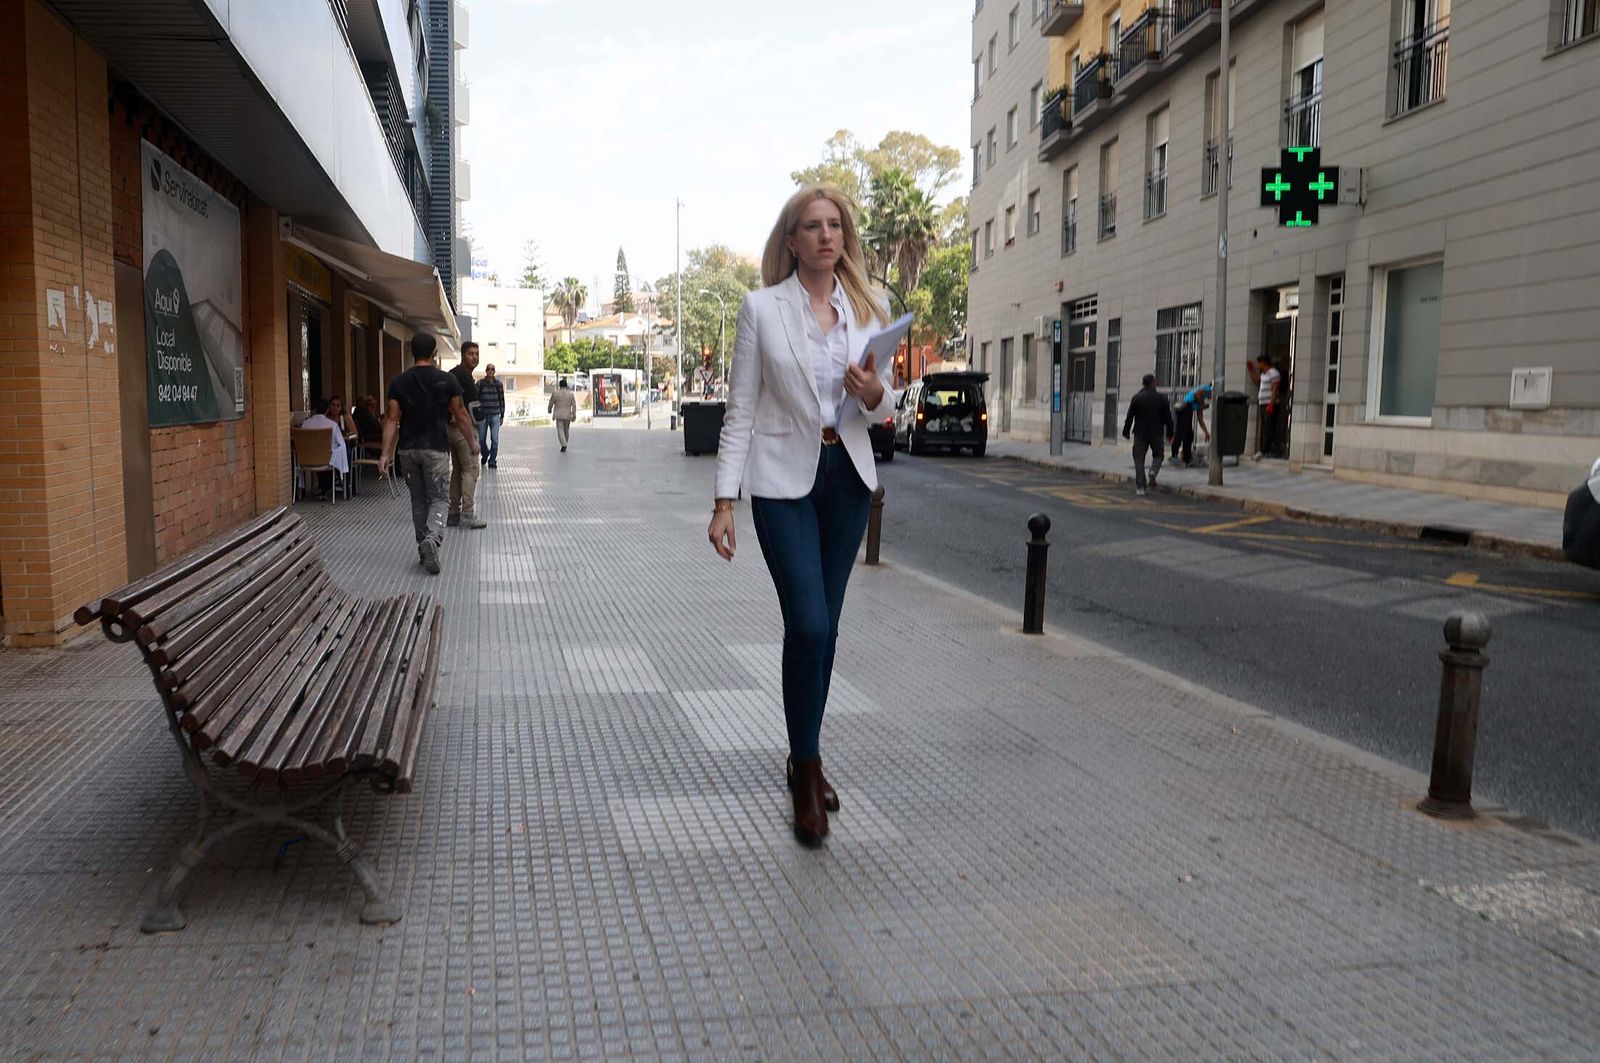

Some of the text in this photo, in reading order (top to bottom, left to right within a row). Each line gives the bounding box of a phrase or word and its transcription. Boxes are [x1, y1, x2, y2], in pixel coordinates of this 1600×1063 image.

[156, 325, 176, 348] Local
[157, 350, 193, 375] Disponible
[172, 384, 182, 402] 04
[190, 386, 198, 401] 47
